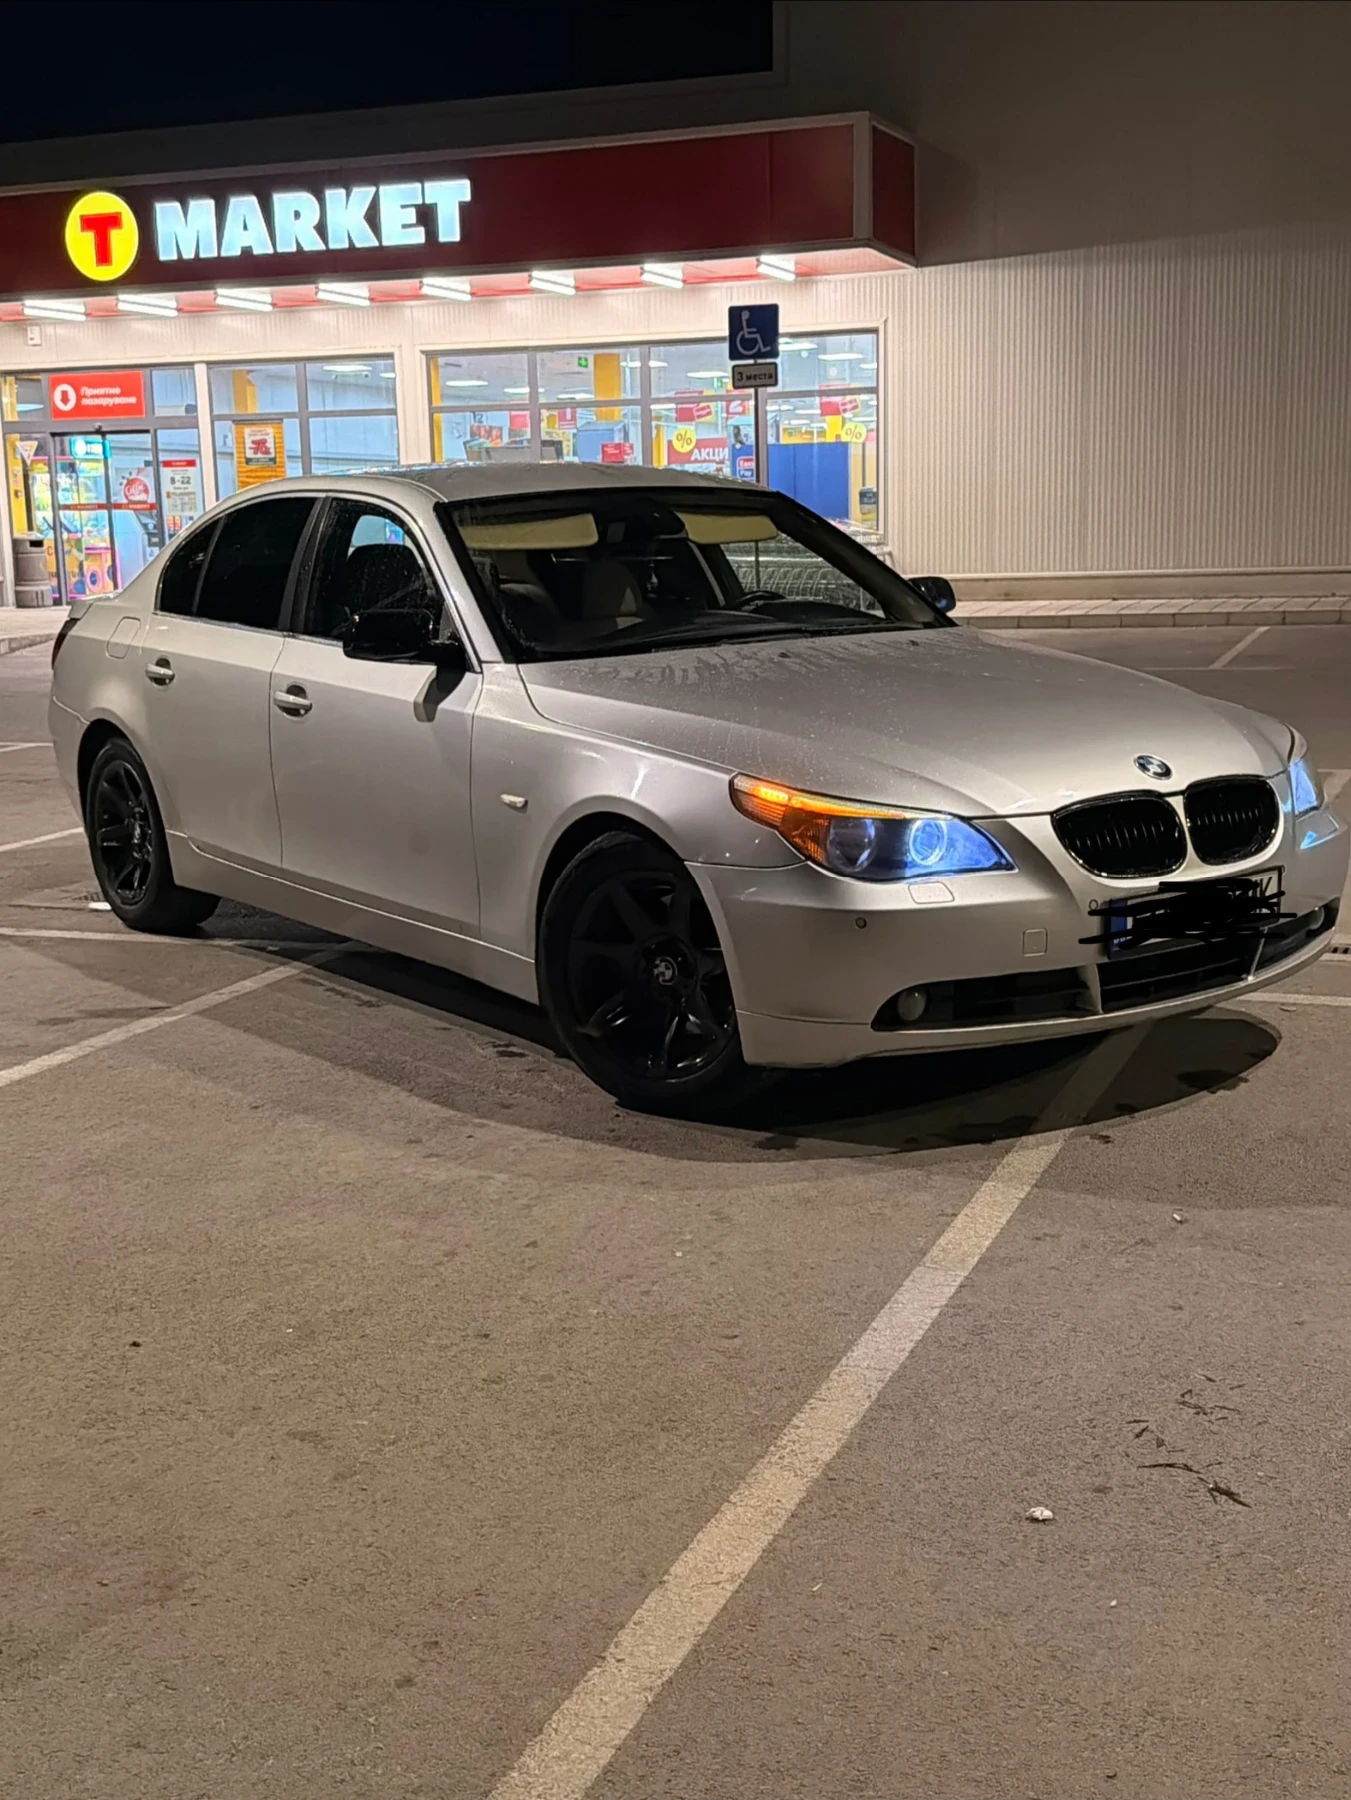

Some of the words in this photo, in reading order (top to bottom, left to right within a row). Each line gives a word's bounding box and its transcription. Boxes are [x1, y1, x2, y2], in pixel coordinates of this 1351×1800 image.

[80, 212, 122, 267] T
[155, 178, 471, 262] MARKET
[737, 371, 744, 381] 3
[745, 373, 774, 381] места
